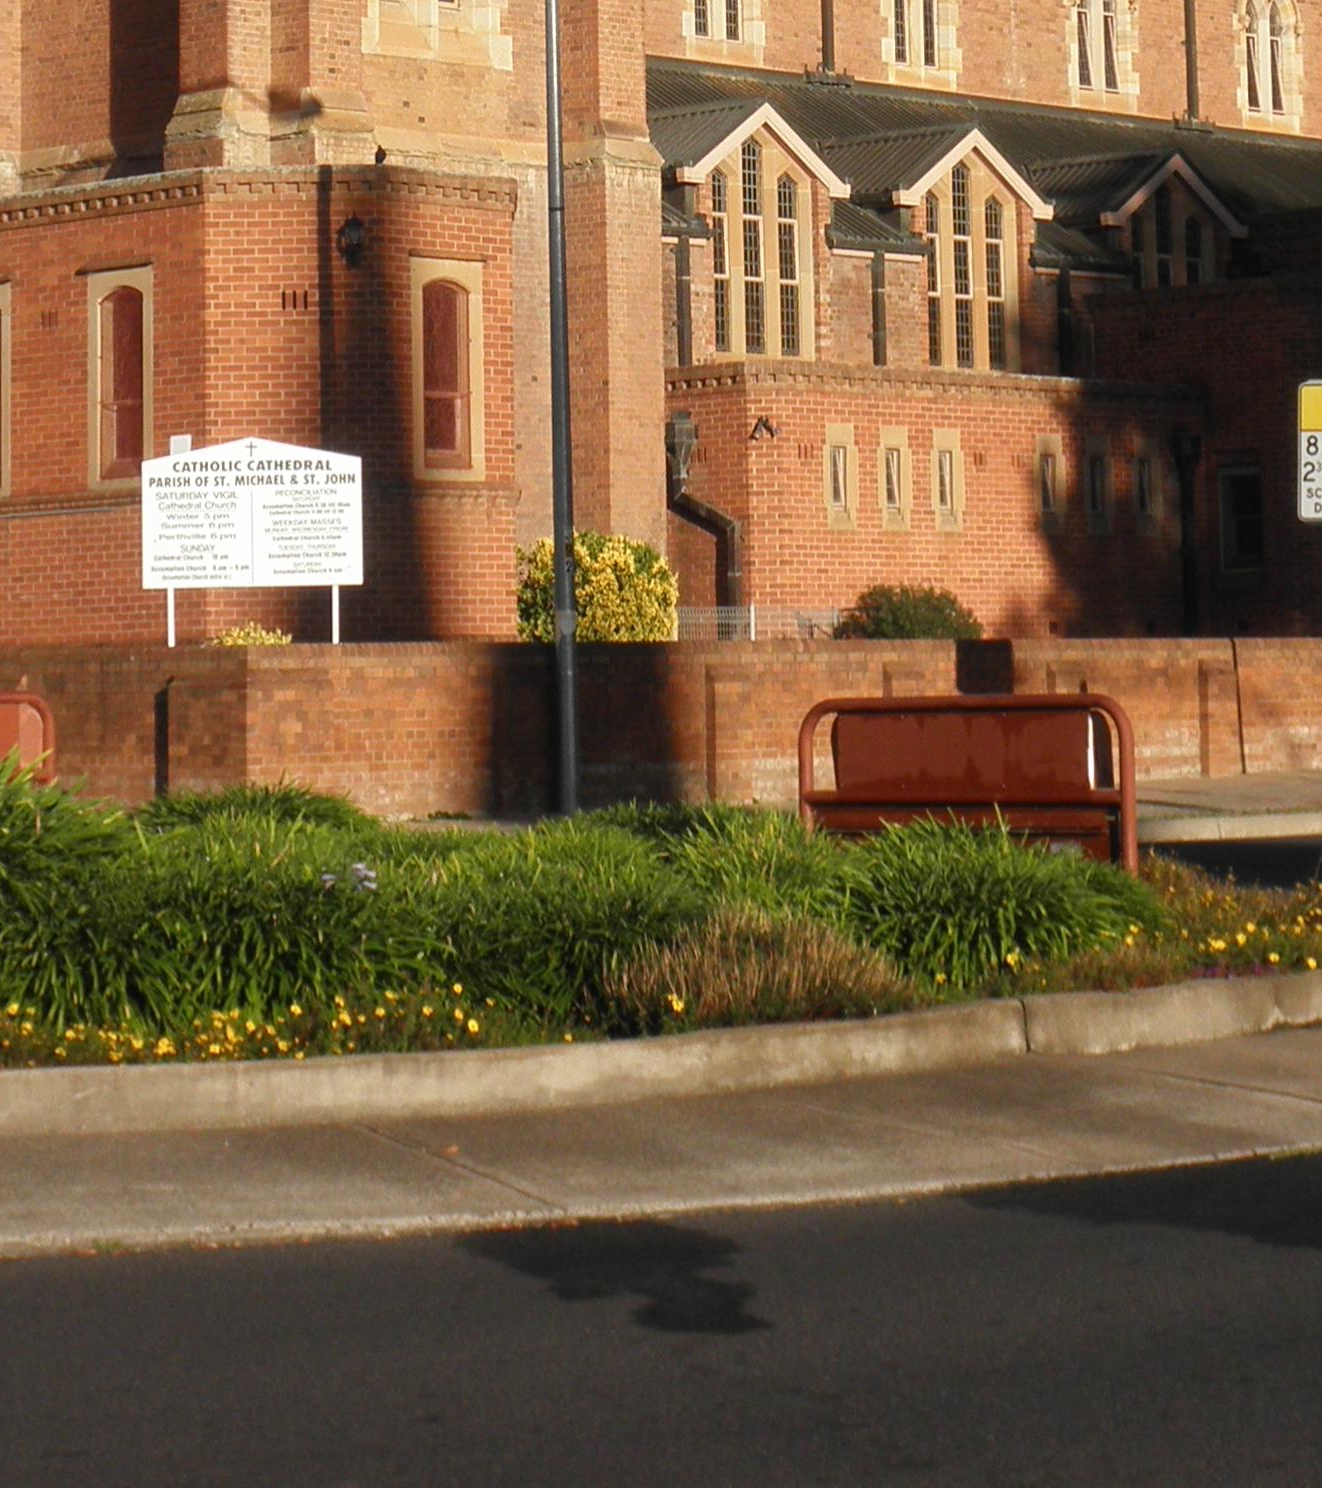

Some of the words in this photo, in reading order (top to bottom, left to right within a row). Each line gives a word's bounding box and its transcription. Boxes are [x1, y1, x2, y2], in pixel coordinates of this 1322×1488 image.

[172, 460, 242, 473] CATHOLIC
[247, 460, 332, 472] CATHEDRAL
[149, 477, 191, 488] PARISH
[195, 477, 209, 487] OF
[214, 476, 230, 487] ST.
[234, 474, 285, 487] MICHAEL
[290, 474, 298, 485] &
[304, 474, 320, 485] ST.
[325, 473, 356, 485] JOHN
[155, 491, 209, 500] SATURDAY
[213, 491, 238, 499] VIGIL
[158, 501, 202, 510] Cathedral
[204, 500, 237, 510] Church
[213, 513, 230, 521] pm
[161, 522, 204, 530] Summer
[218, 522, 235, 530] pm
[180, 544, 215, 553] SUNDAY
